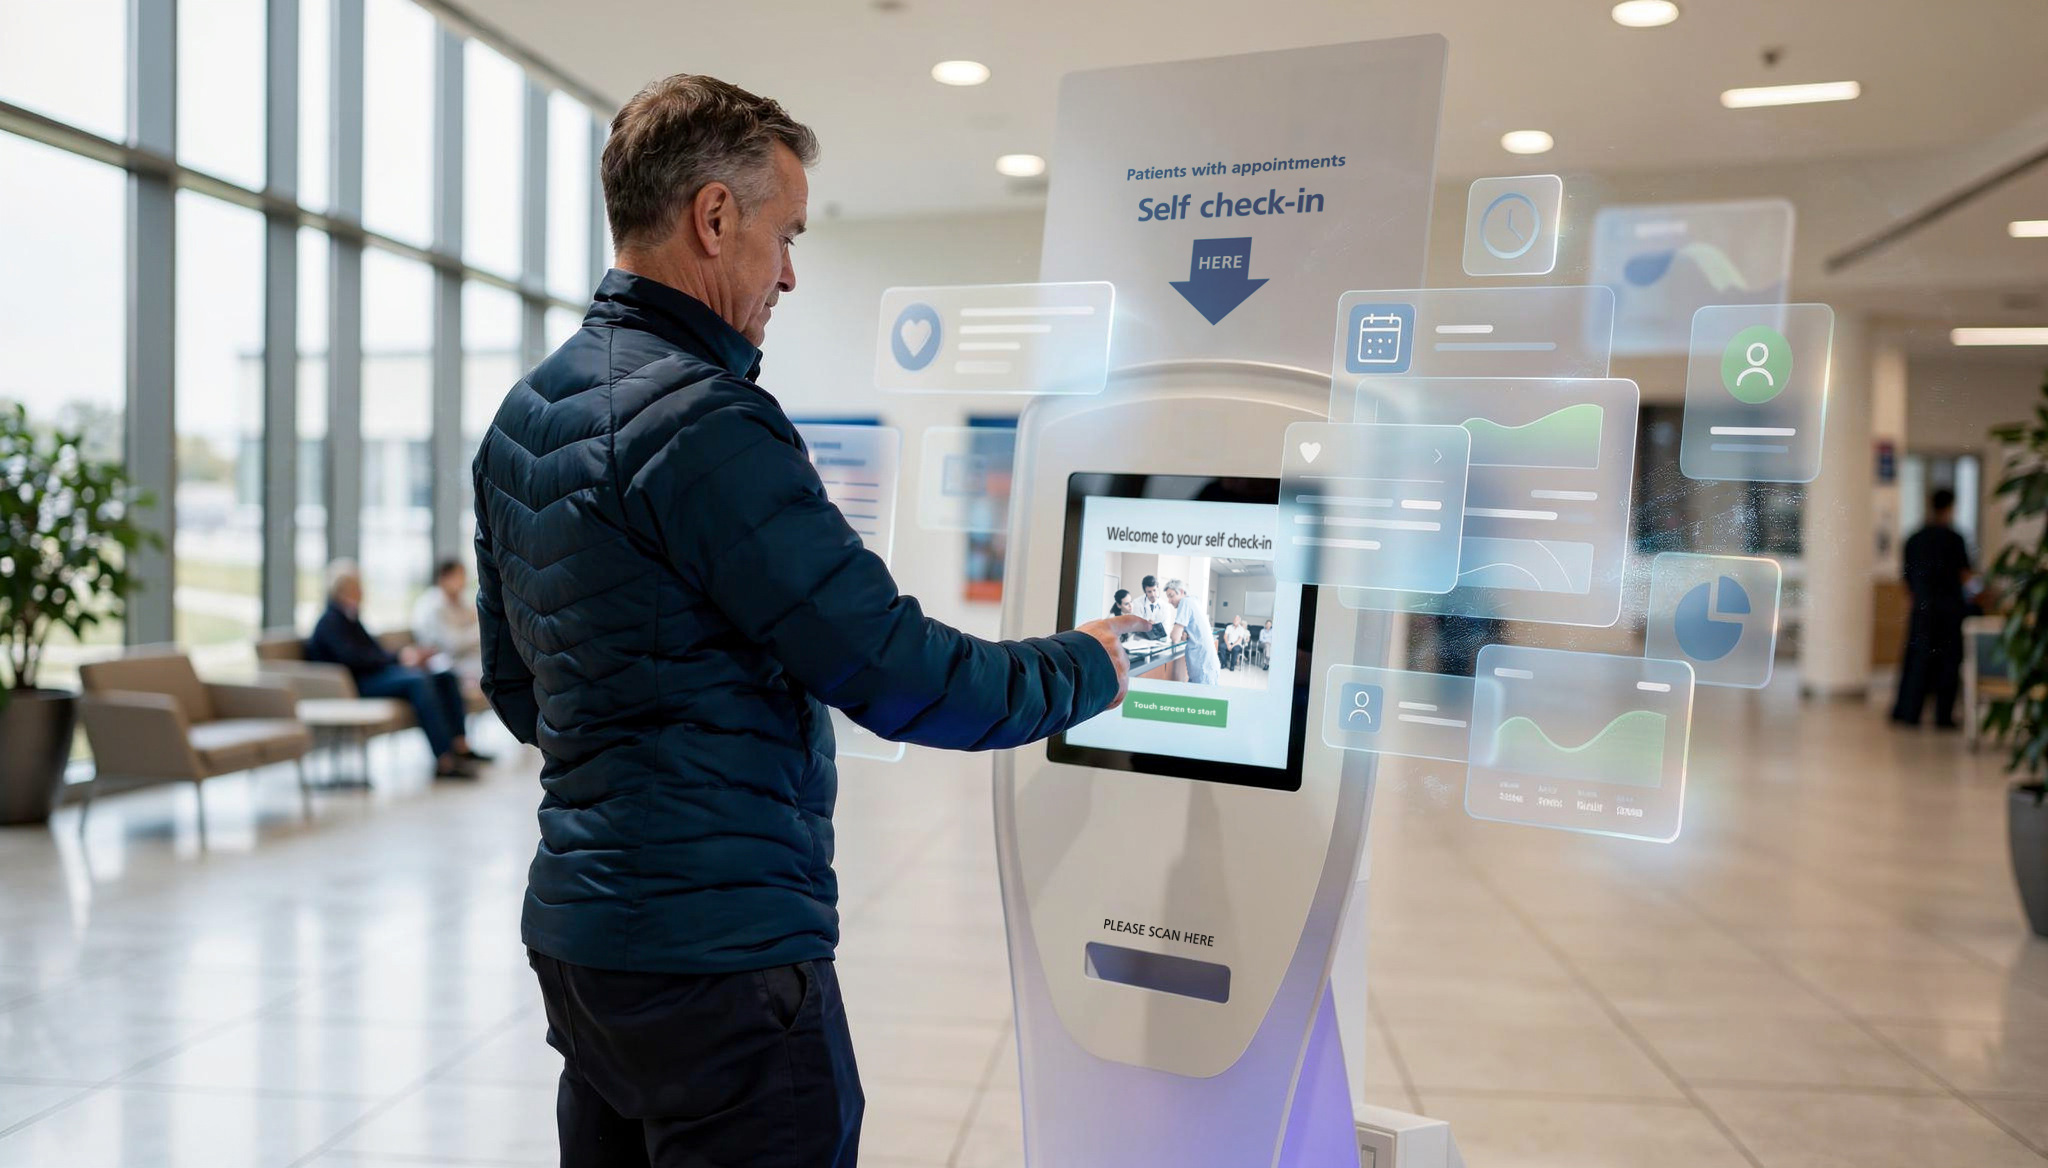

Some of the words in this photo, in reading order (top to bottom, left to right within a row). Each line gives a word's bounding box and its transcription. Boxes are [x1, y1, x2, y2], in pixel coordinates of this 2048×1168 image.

[1127, 165, 1187, 181] Patients
[1191, 161, 1227, 177] with
[1231, 154, 1346, 176] appointments
[1138, 193, 1191, 222] Self
[1200, 187, 1325, 218] check-in
[1198, 255, 1243, 270] HERE
[1107, 526, 1158, 543] Welcome
[1162, 530, 1174, 544] to
[1177, 533, 1202, 548] your
[1205, 532, 1225, 547] self
[1228, 533, 1272, 550] check-in
[1133, 701, 1157, 711] Touch
[1159, 704, 1185, 713] screen
[1197, 708, 1216, 716] start
[1103, 918, 1146, 936] PLEASE
[1148, 926, 1181, 941] SCAN
[1183, 931, 1215, 947] HERE
